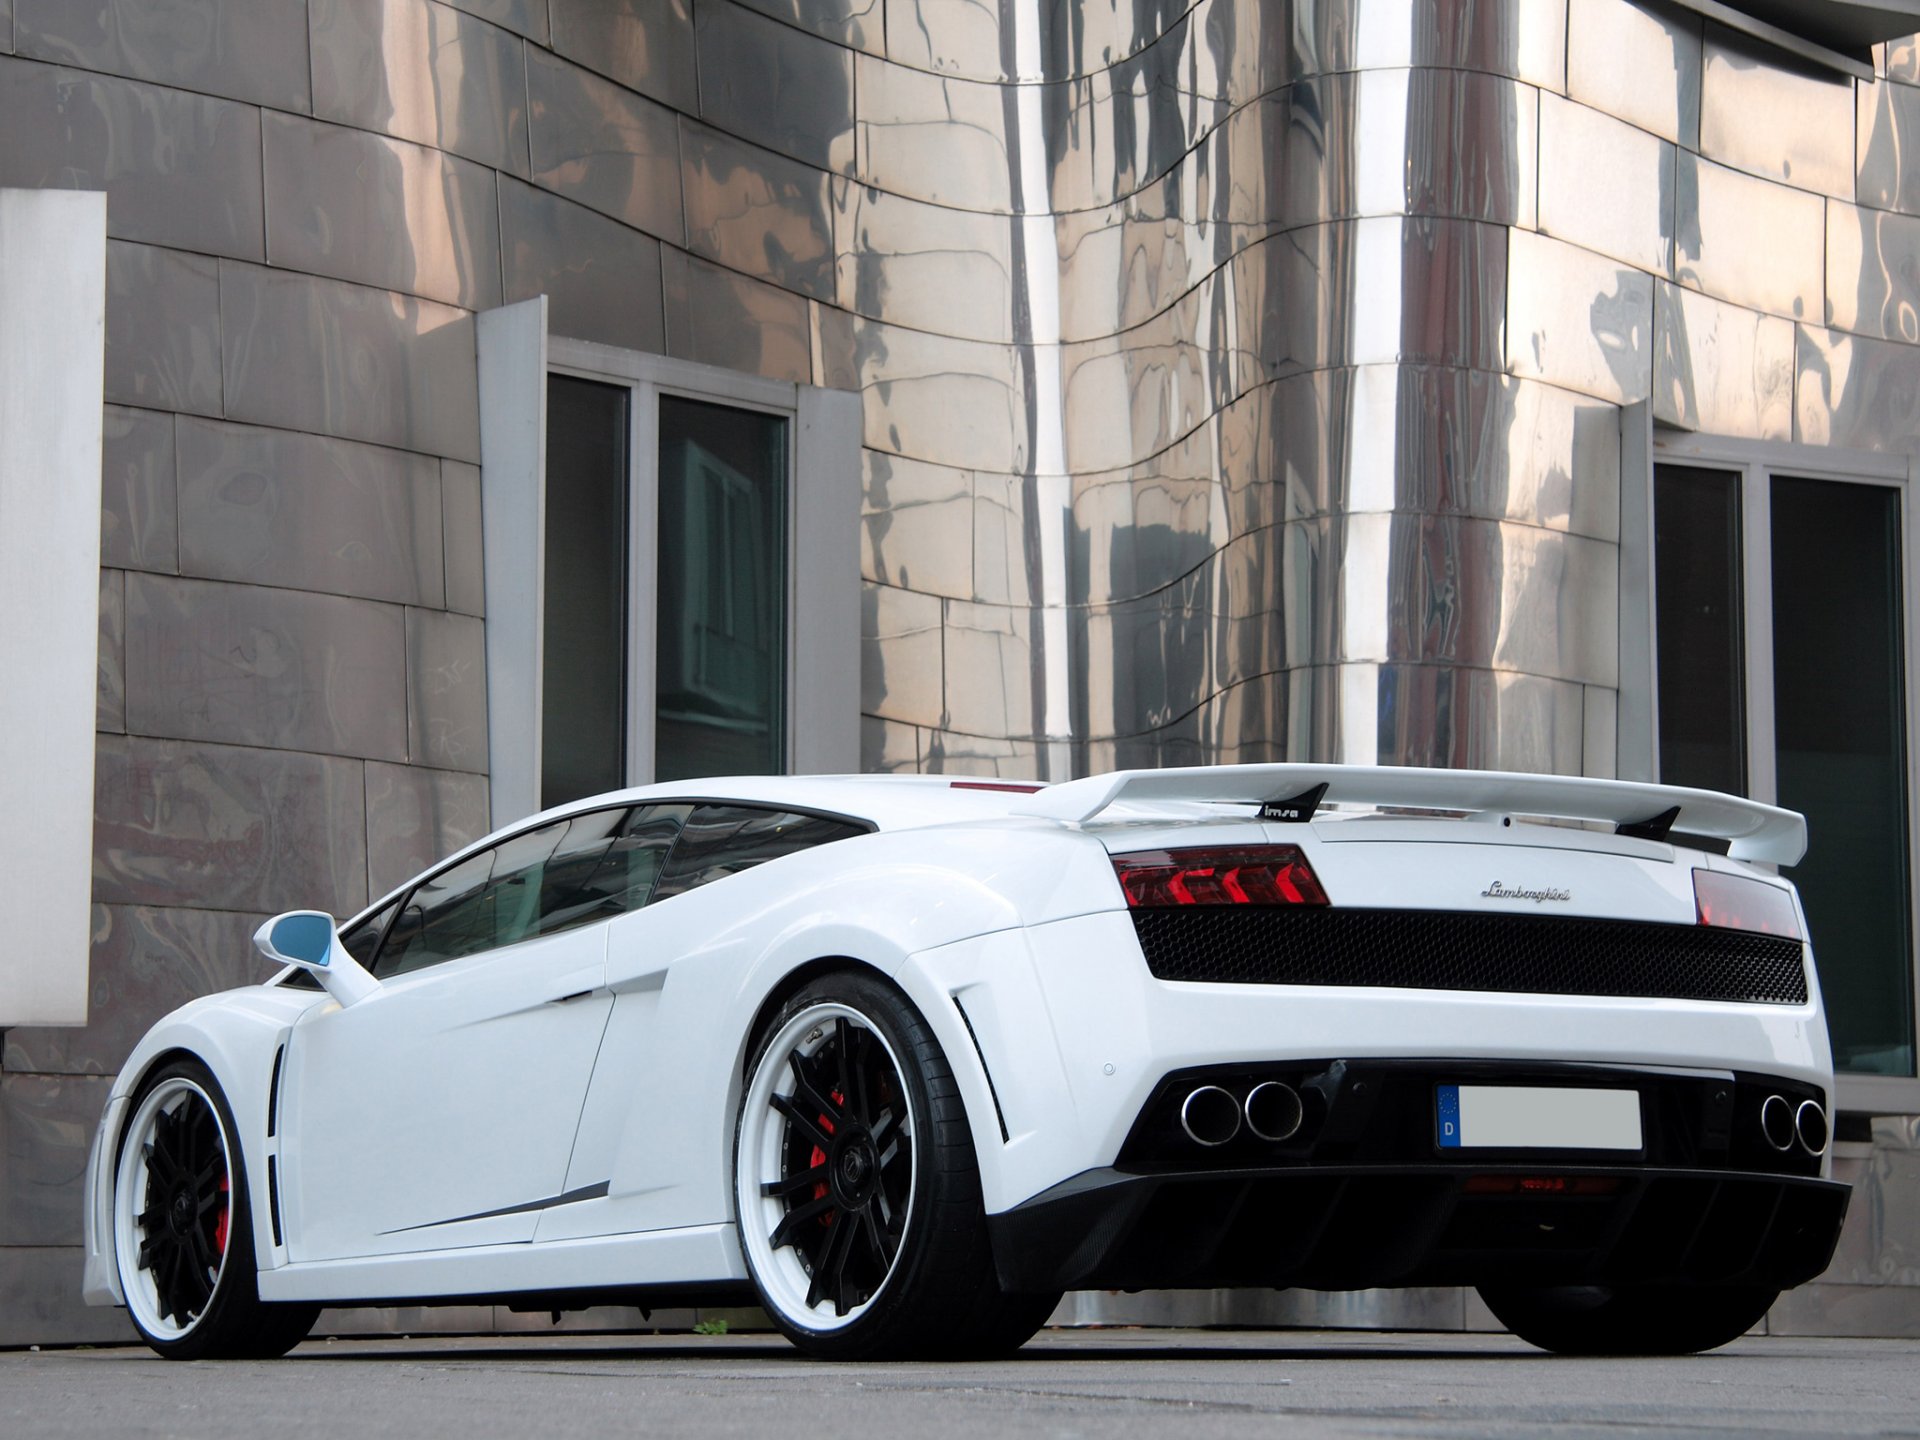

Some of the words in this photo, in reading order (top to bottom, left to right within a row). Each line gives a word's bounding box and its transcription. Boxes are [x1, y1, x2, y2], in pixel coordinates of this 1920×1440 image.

[1264, 804, 1299, 818] imsa
[1481, 880, 1571, 903] Lamborghini
[1444, 1122, 1454, 1136] D
